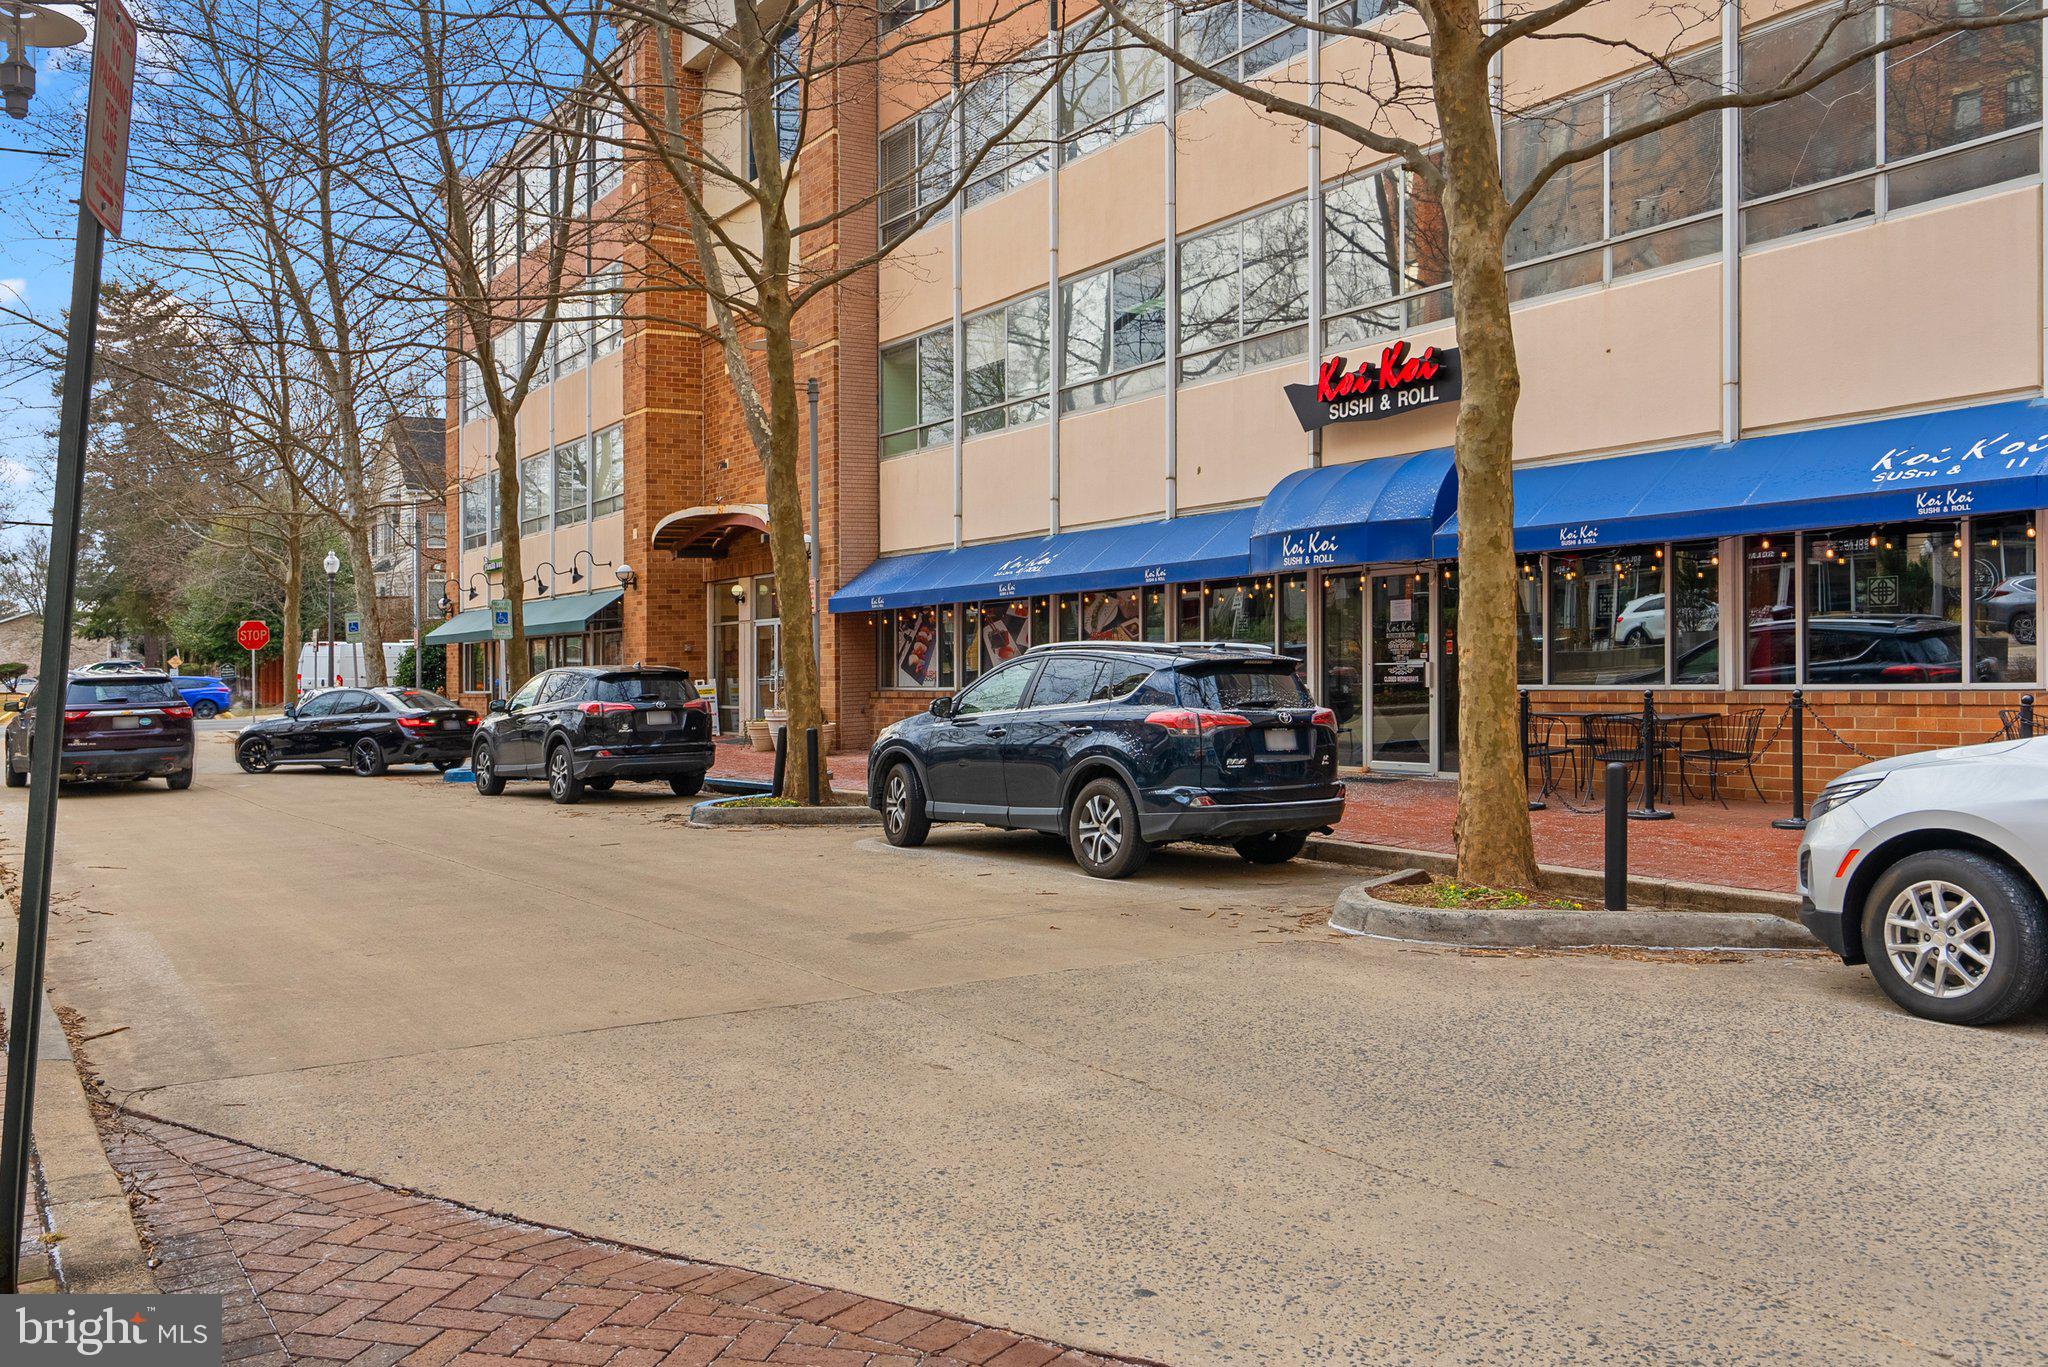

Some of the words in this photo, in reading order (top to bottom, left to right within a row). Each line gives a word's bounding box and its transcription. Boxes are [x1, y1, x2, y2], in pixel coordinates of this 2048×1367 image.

[111, 38, 121, 71] NO
[99, 49, 128, 114] PARKING
[104, 98, 118, 130] FIRE
[102, 121, 117, 155] LANE
[1317, 356, 1374, 403] Koi
[1379, 340, 1440, 390] Koi
[1329, 397, 1374, 420] SUSHI
[1379, 393, 1391, 411] &
[1397, 385, 1440, 407] ROLL
[1871, 447, 1952, 471] Koi
[1961, 432, 2048, 461] Koi
[1946, 464, 1962, 475] &
[1916, 491, 1943, 508] Koi
[1946, 488, 1974, 506] Koi
[1918, 506, 1941, 515] SUSHI
[1943, 505, 1948, 513] &
[1951, 503, 1971, 512] ROLL
[1282, 534, 1305, 557] Koi
[1308, 531, 1338, 553] Koi
[1560, 527, 1578, 541] Koi
[1580, 524, 1599, 538] Koi
[1283, 556, 1302, 566] SUSHI
[1305, 555, 1310, 564] &
[1313, 554, 1334, 563] ROLL
[240, 630, 267, 641] STOP
